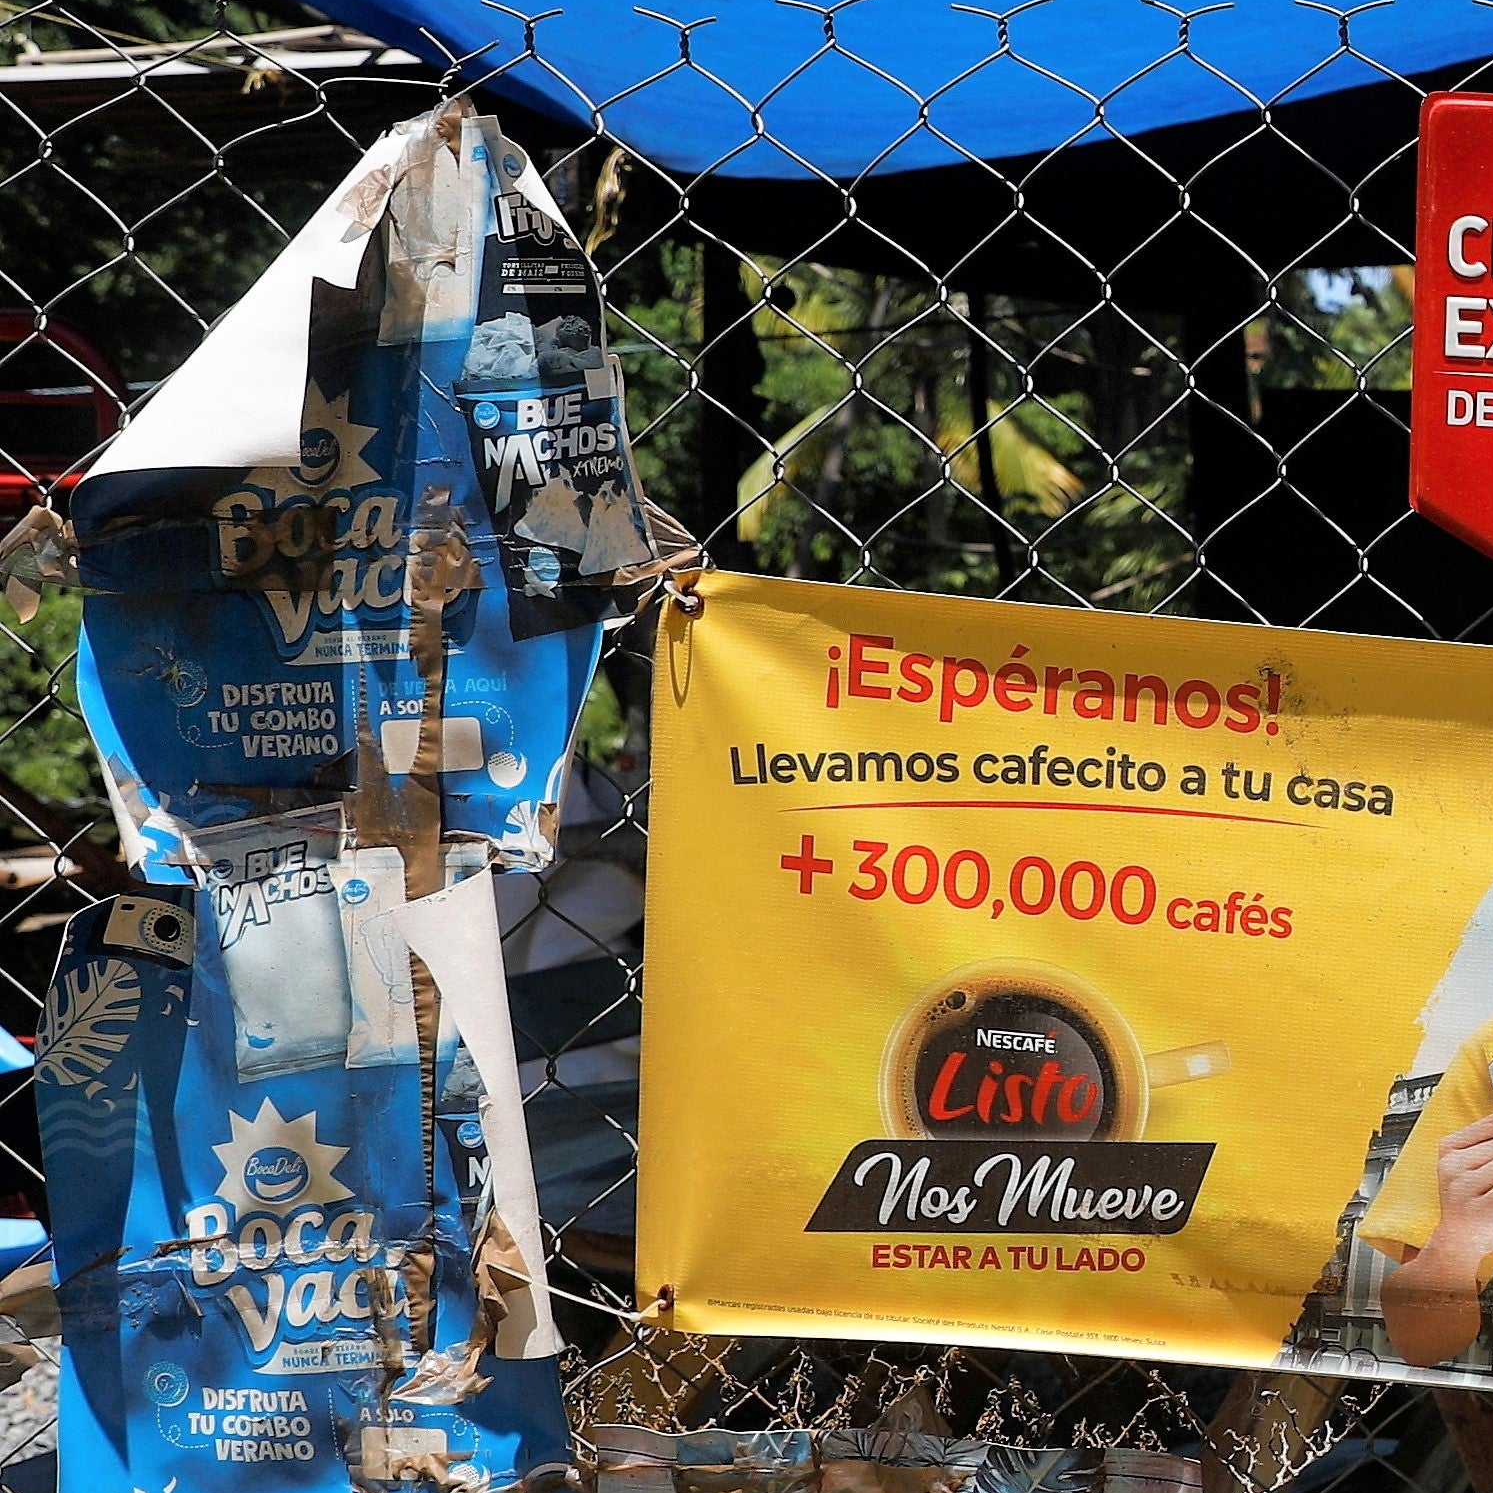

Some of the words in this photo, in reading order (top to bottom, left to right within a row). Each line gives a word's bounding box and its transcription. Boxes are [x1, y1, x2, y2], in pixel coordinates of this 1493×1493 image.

[517, 393, 583, 431] BUE
[484, 422, 617, 515] NACHOS
[222, 681, 335, 708] DISFRUTA
[464, 672, 508, 693] AQUÍ
[823, 633, 1284, 736] ¡Espéranos!
[208, 710, 240, 734] TU
[250, 708, 336, 732] COMBO
[379, 701, 392, 716] A
[397, 700, 425, 715] SOL
[241, 733, 339, 759] VERANO
[729, 744, 960, 788] Llevamos
[972, 744, 1167, 795] cafecito
[1178, 766, 1206, 797] a
[1221, 761, 1272, 803] tu
[1283, 773, 1395, 817] casa
[245, 841, 307, 880] BUE
[847, 839, 1158, 926] 300,000
[1164, 889, 1295, 940] cafés
[219, 864, 336, 950] NACHOS
[976, 1028, 1057, 1054] NESCAFÉ
[928, 1050, 1099, 1126] Listo
[853, 1151, 978, 1226] Nos
[973, 1152, 1185, 1227] Mueve
[185, 1203, 381, 1286] Boca
[872, 1244, 972, 1271] ESTAR
[979, 1245, 997, 1271] A
[1007, 1245, 1050, 1271] TU
[1055, 1247, 1146, 1272] LADO
[282, 1355, 330, 1368] NUNCA
[202, 1387, 308, 1413] DISFRUTA
[188, 1413, 216, 1436] TU
[222, 1414, 311, 1438] COMBO
[359, 1408, 372, 1422] A
[215, 1438, 315, 1463] VERANO
